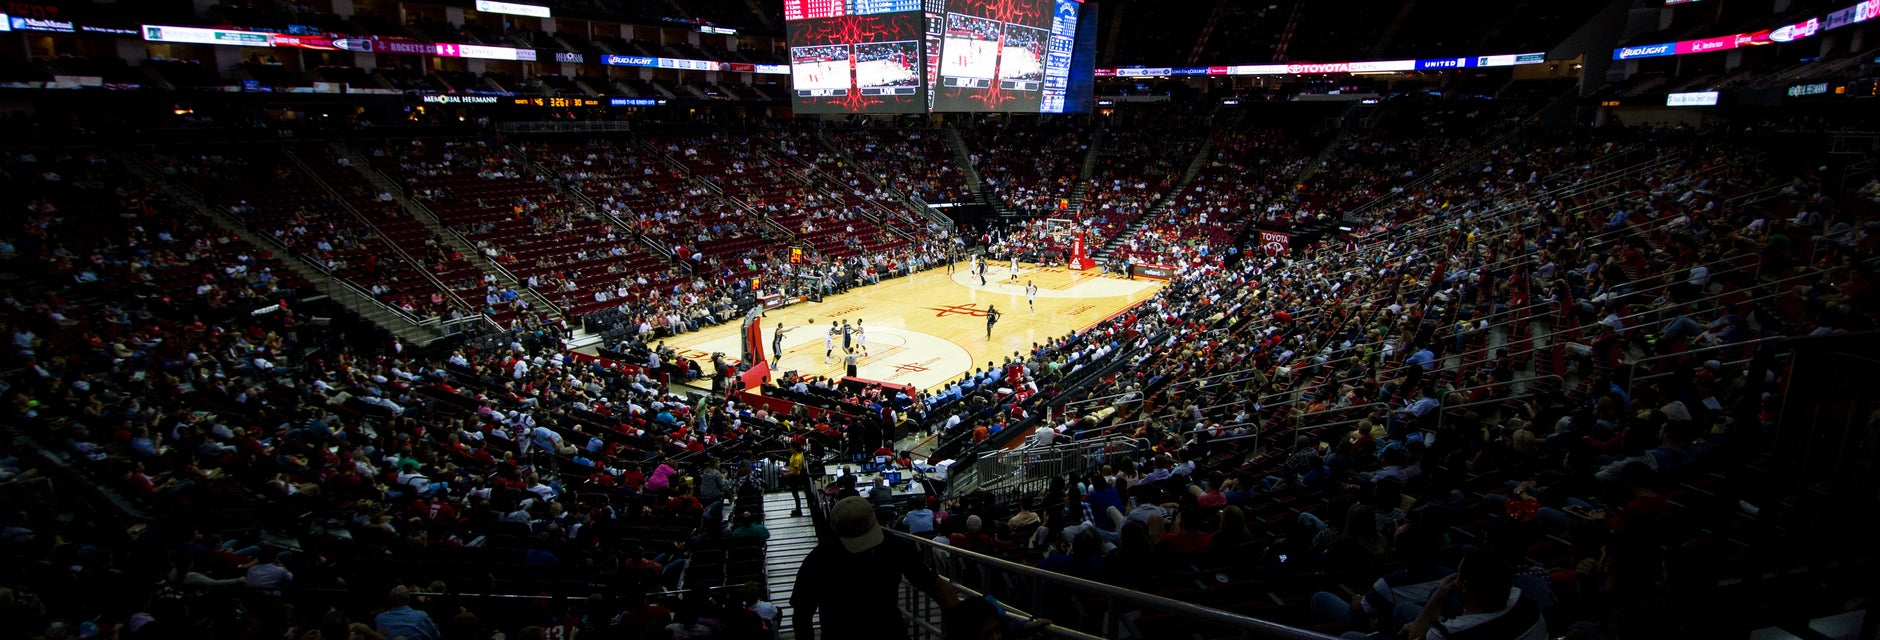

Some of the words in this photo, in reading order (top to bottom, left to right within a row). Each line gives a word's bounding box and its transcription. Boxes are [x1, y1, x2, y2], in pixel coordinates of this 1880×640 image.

[1641, 46, 1668, 54] LIGHT
[1302, 64, 1348, 73] TOYOTA
[424, 95, 461, 104] MEMORIAL
[1262, 233, 1288, 243] TOYOTA
